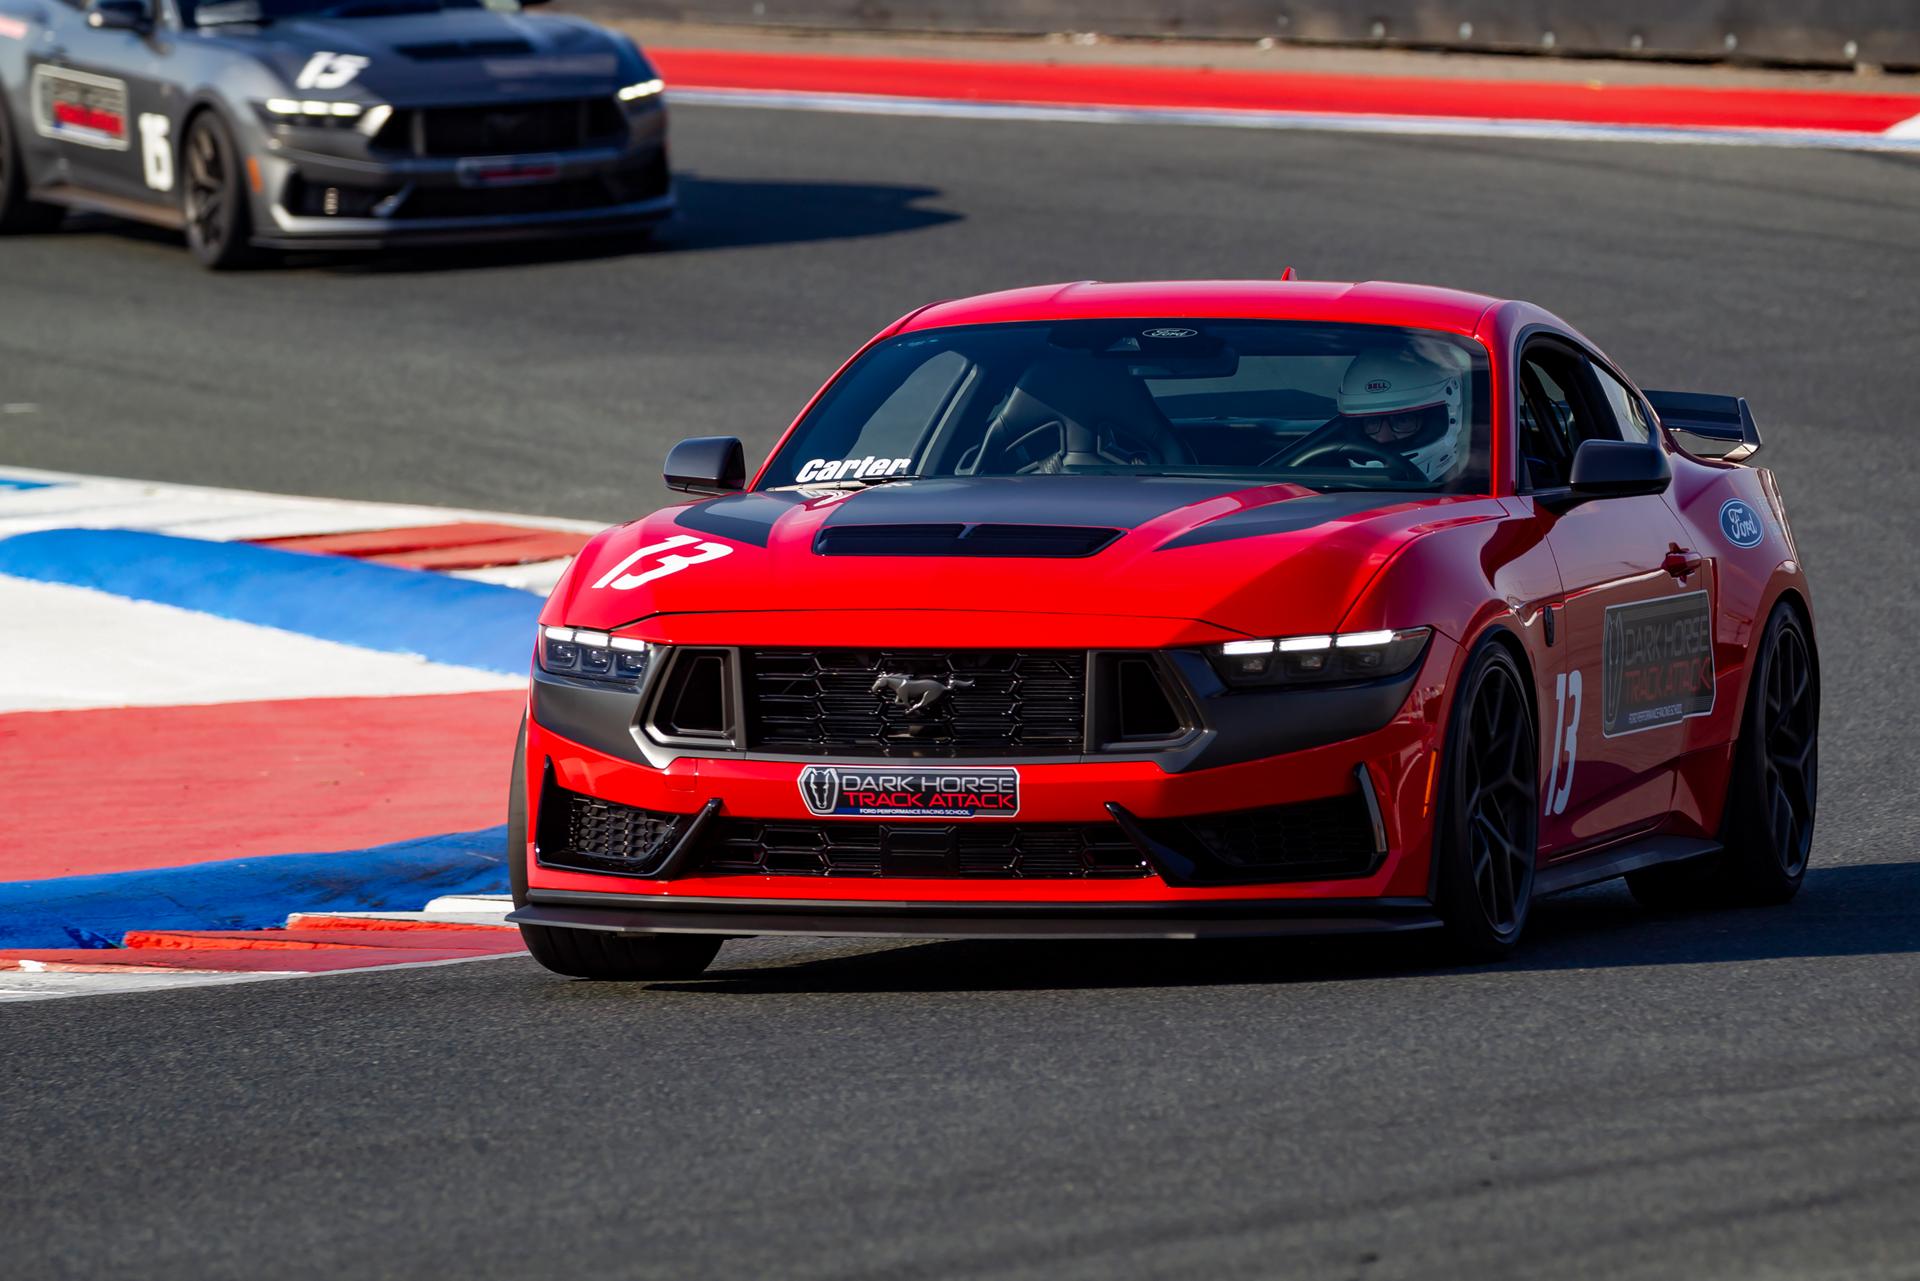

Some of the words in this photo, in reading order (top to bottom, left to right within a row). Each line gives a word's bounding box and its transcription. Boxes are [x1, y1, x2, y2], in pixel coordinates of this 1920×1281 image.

[296, 51, 370, 89] 15
[1367, 382, 1388, 390] BELL
[796, 456, 911, 483] Carter
[1728, 508, 1757, 539] Ford
[591, 534, 734, 590] 13
[1624, 623, 1662, 666] DARK
[1664, 615, 1708, 658] HORSE
[1624, 664, 1664, 704] TRACK
[1665, 655, 1712, 696] ATTACK
[1544, 670, 1583, 817] 13
[842, 775, 914, 792] DARK
[921, 776, 1014, 793] HORSE
[843, 791, 924, 808] TRACK
[930, 793, 1015, 809] ATTACK
